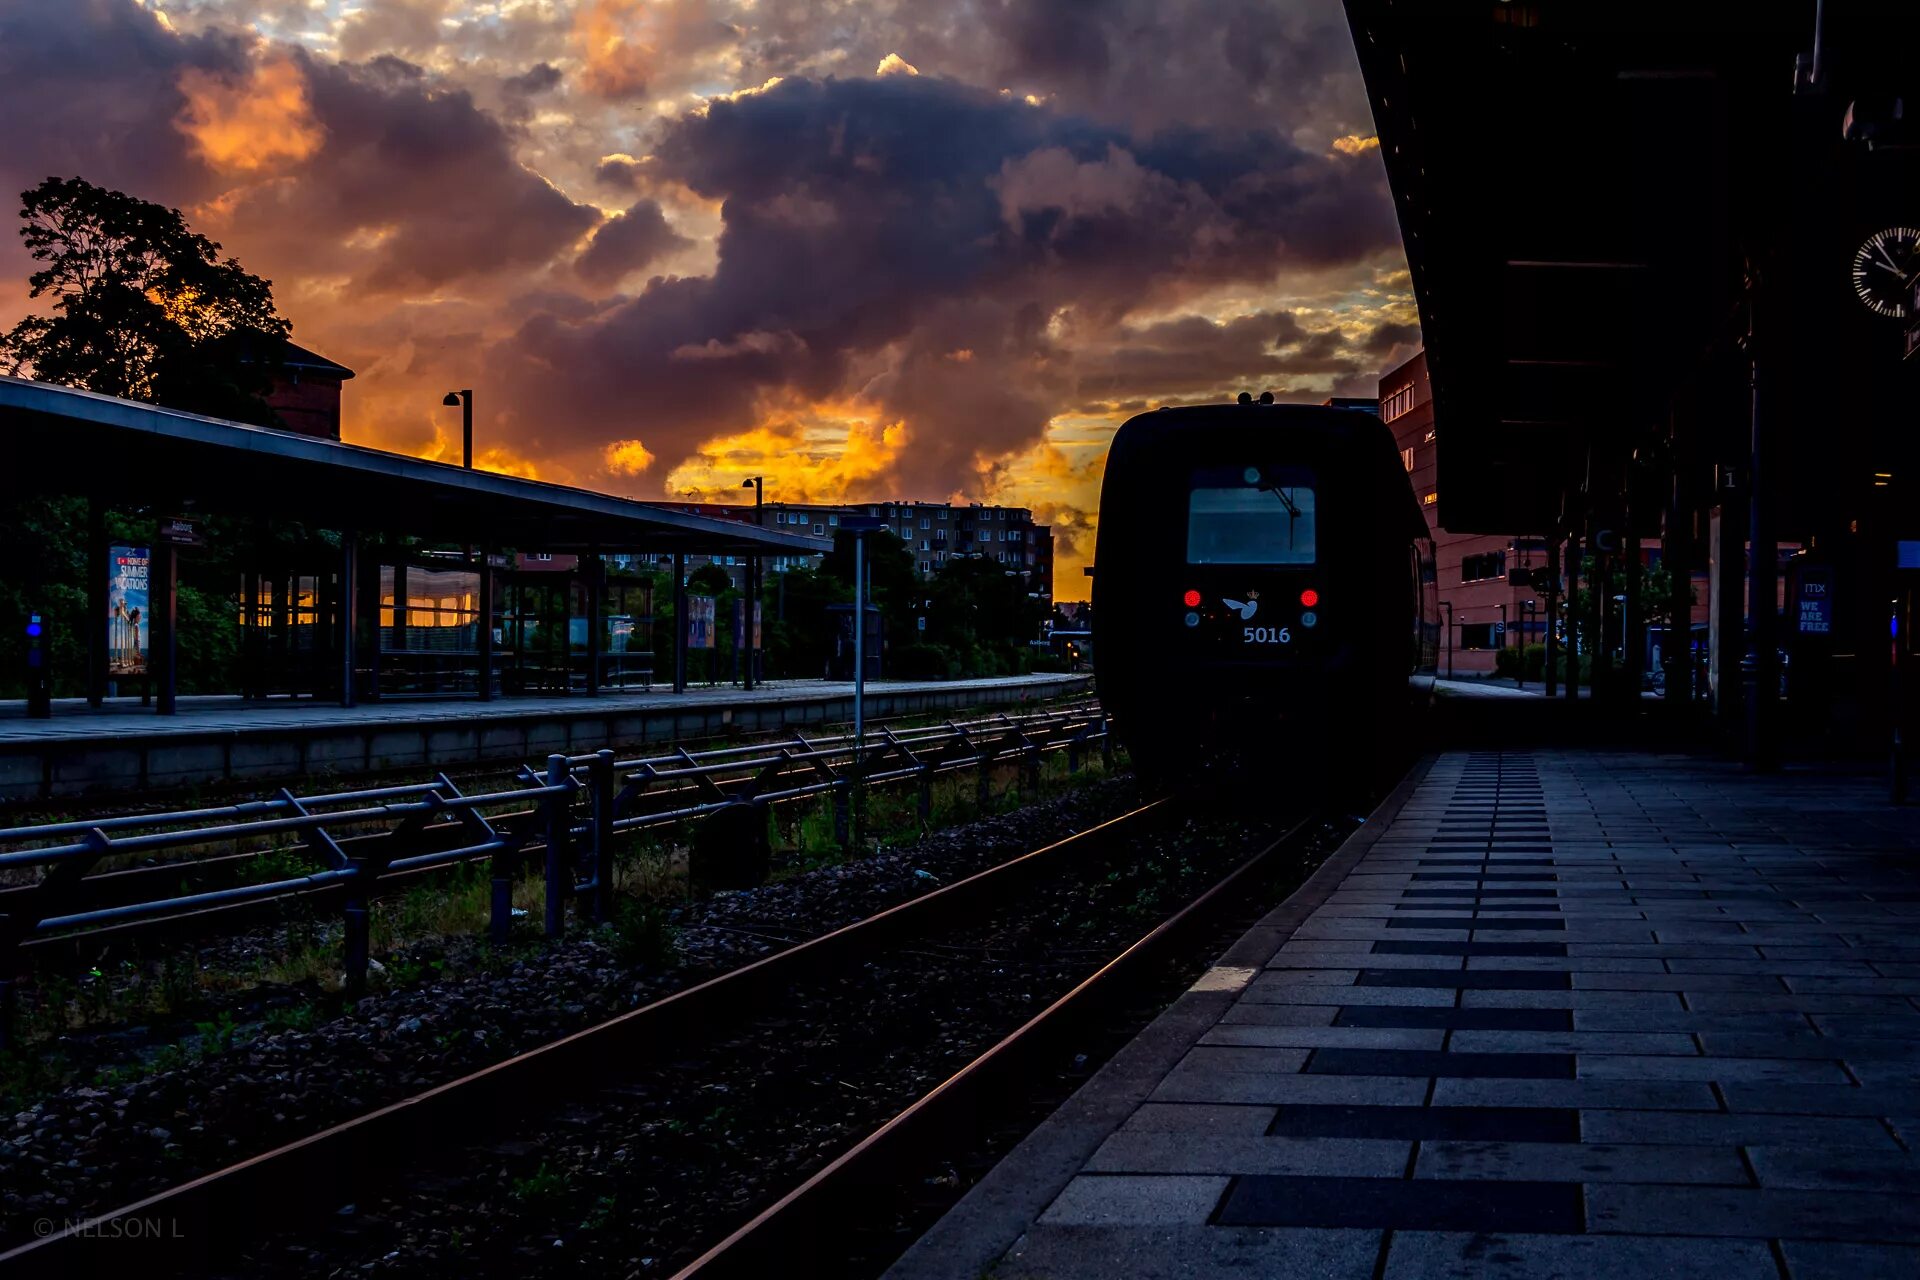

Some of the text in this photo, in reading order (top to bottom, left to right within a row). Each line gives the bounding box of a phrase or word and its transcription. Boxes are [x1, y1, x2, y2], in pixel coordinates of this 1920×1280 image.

[120, 565, 148, 577] SUMMER
[115, 577, 148, 590] VACATIONS
[1800, 601, 1819, 611] WE
[1800, 611, 1823, 621] ARE
[1800, 621, 1830, 632] FREE
[1243, 627, 1291, 643] 5016
